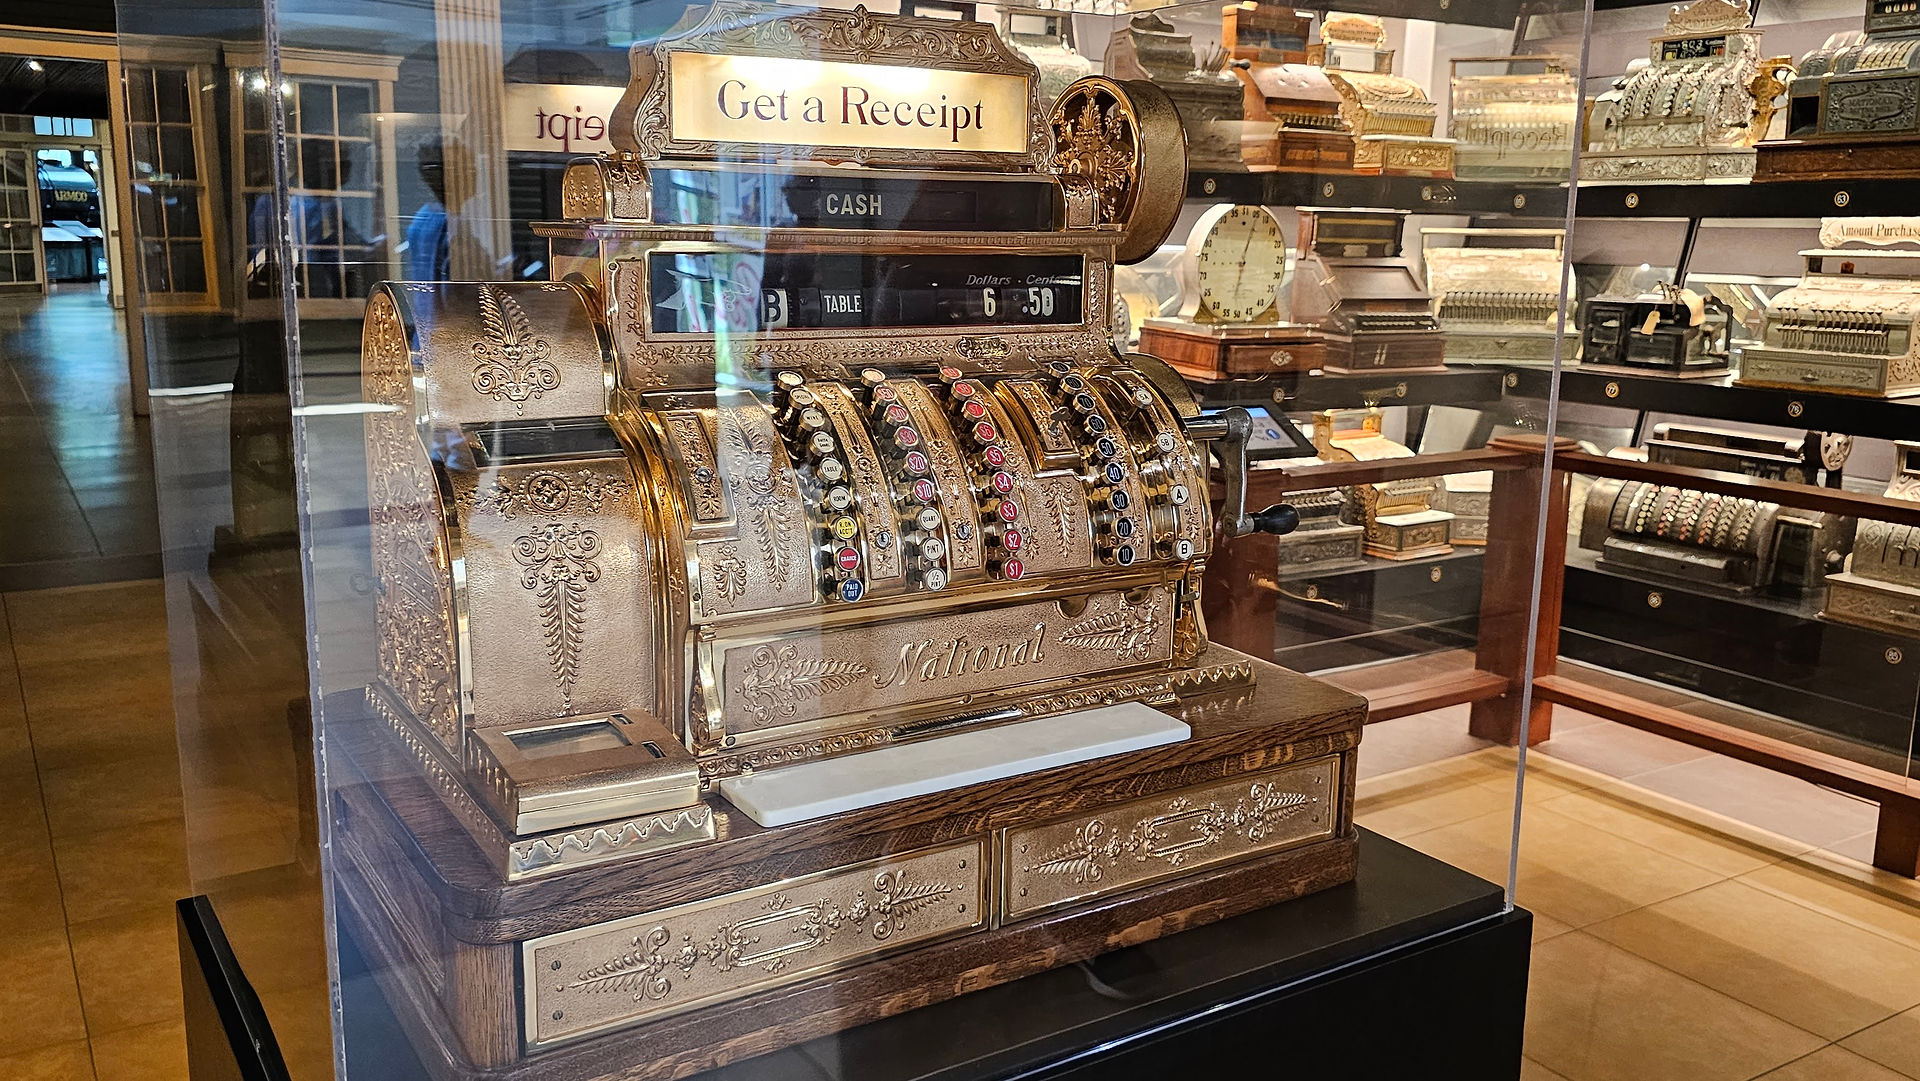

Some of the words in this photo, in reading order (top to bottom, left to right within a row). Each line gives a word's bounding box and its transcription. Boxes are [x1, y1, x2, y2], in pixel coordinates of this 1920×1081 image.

[717, 79, 789, 121] Get
[802, 96, 827, 123] a
[841, 86, 984, 143] Receipt
[826, 193, 882, 216] CASH
[1840, 223, 1874, 237] Amount
[1876, 223, 1920, 237] Purchas
[964, 274, 1012, 286] Dollars
[762, 288, 782, 323] B
[823, 294, 863, 313] TABLE
[982, 286, 997, 317] 6
[1079, 397, 1092, 408] 70
[1091, 418, 1103, 430] 60
[1100, 441, 1113, 455] 50
[1160, 438, 1170, 447] 5B
[989, 448, 1002, 460] $5
[908, 456, 925, 470] $20
[1109, 466, 1121, 481] 40
[997, 475, 1009, 489] $4
[915, 483, 932, 499] $10
[1176, 488, 1184, 501] A
[1113, 493, 1125, 508] 30
[1003, 503, 1015, 518] $3
[1119, 521, 1129, 536] 20
[1008, 533, 1019, 548] $2
[926, 544, 939, 554] PINT
[1121, 548, 1130, 562] 10
[1181, 543, 1188, 555] B
[1009, 563, 1019, 576] $1
[846, 583, 859, 591] PAID
[872, 621, 1046, 690] National
